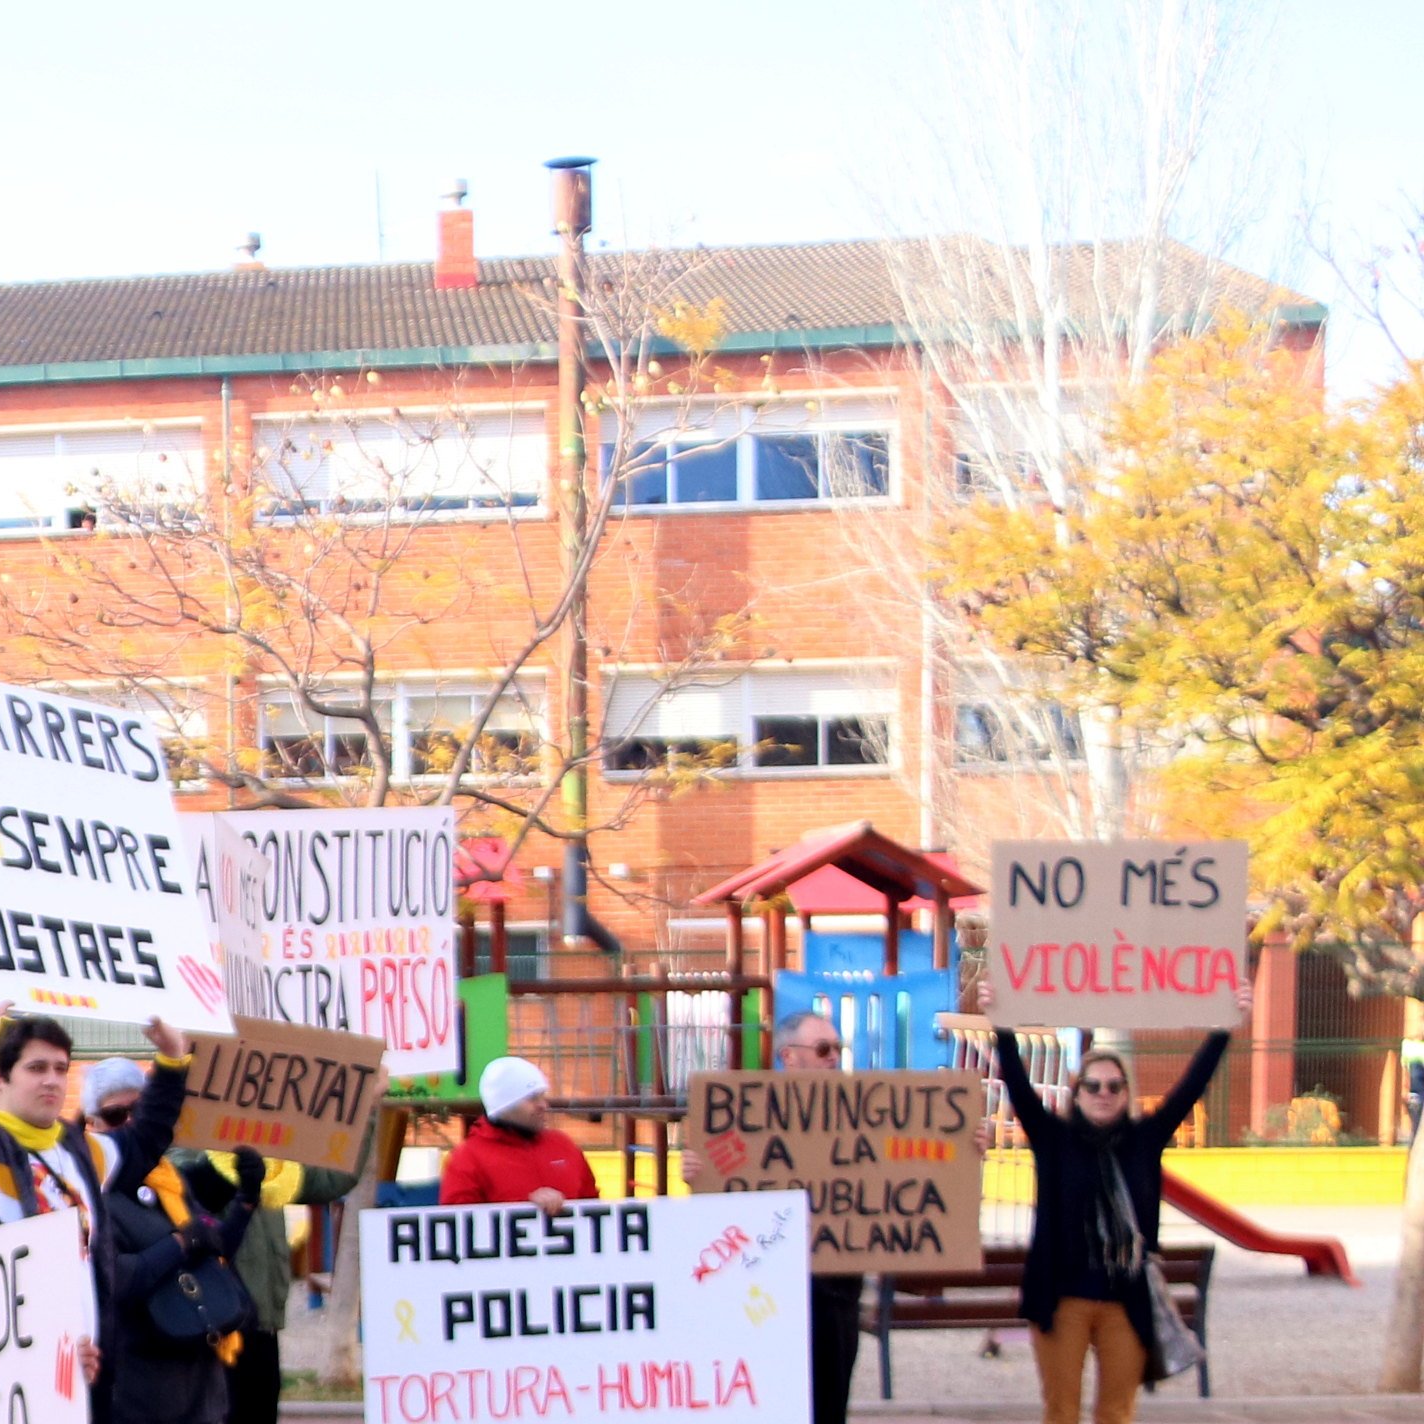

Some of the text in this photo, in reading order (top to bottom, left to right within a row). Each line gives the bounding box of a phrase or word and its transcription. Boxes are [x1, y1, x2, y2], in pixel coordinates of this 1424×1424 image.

[1009, 846, 1220, 908] NO MÉS
[1000, 928, 1239, 997] VIOLÈNCIA
[359, 939, 449, 1050] PRESÓ
[704, 1080, 968, 1134] BENVINGUTS
[761, 1134, 877, 1170] A LA
[388, 1204, 651, 1263] AQUESTA
[441, 1282, 655, 1341] POLICIA
